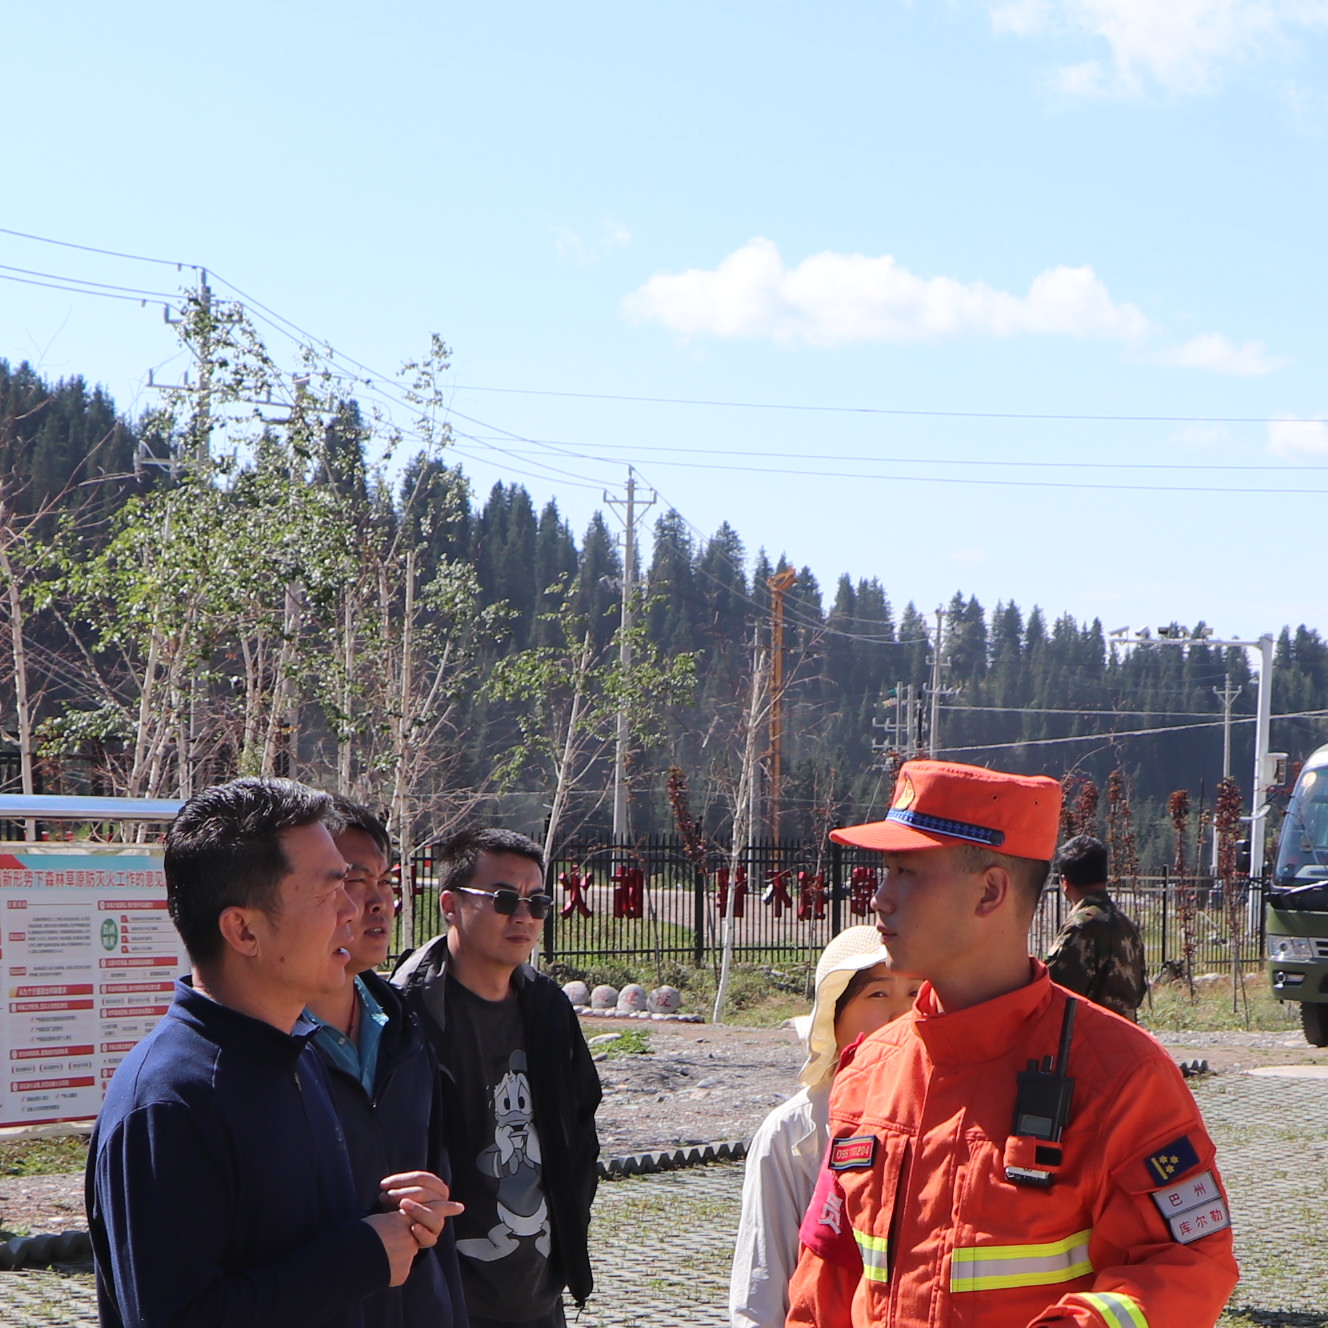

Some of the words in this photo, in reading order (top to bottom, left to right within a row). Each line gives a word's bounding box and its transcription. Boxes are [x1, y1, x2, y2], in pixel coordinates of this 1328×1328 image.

[1168, 1182, 1207, 1207] 巴州
[1178, 1208, 1223, 1236] 库尔勒
